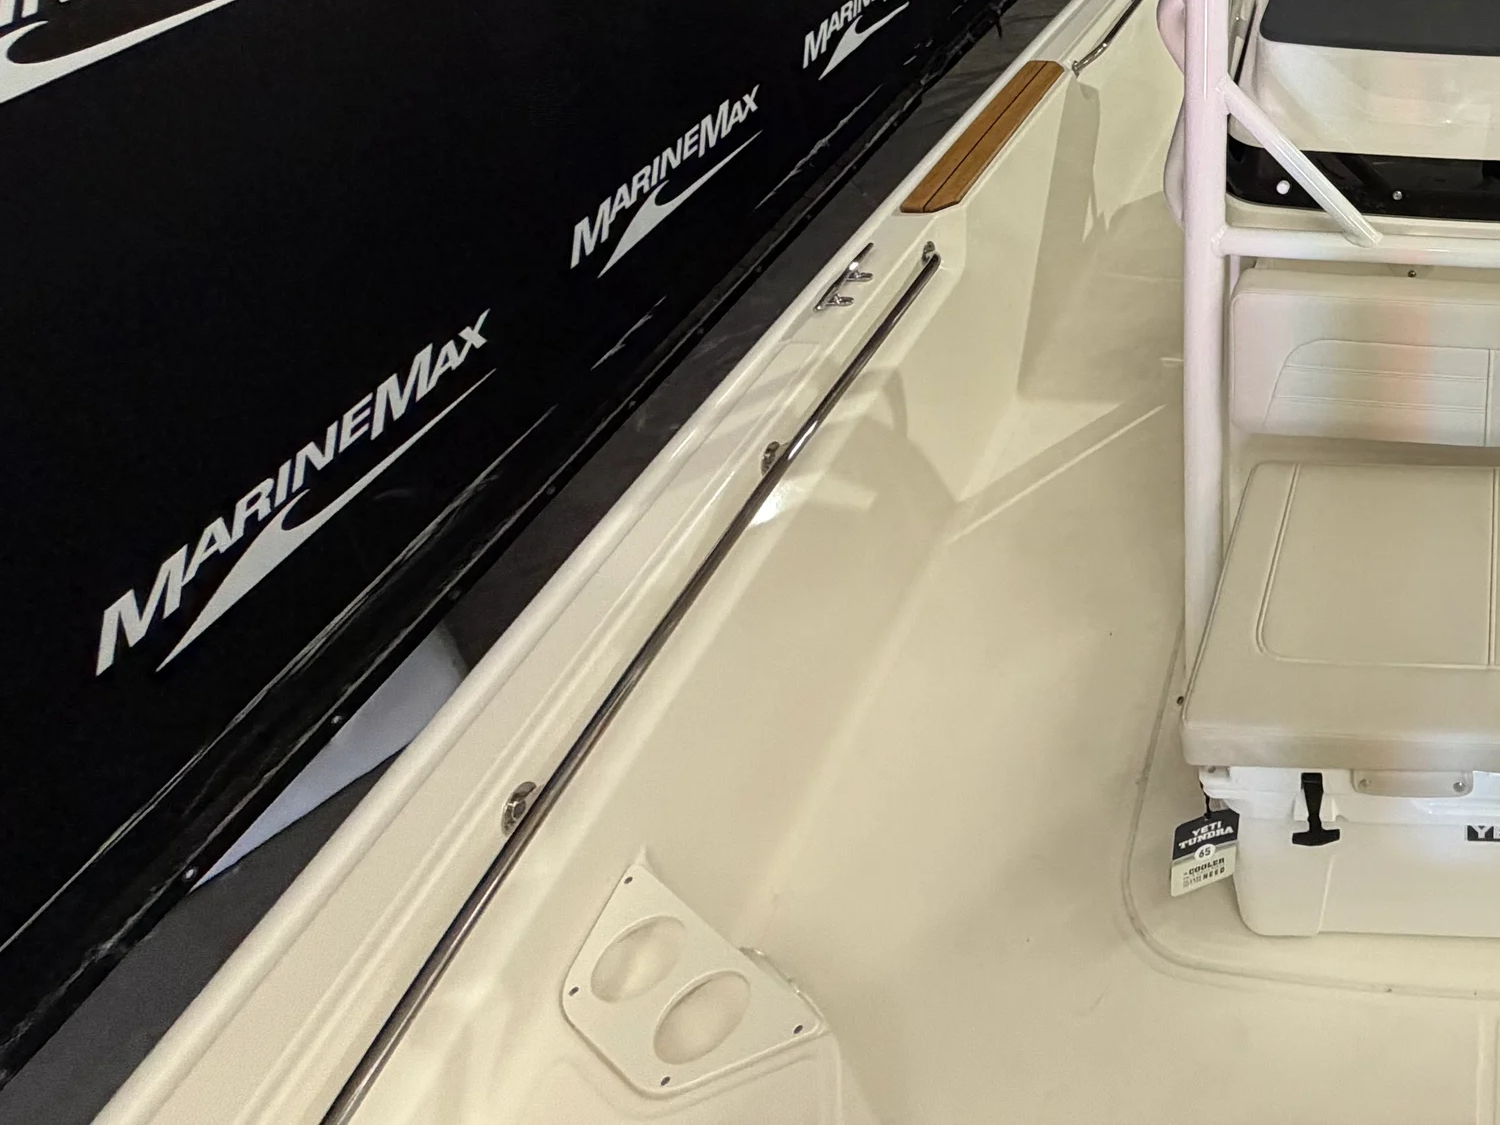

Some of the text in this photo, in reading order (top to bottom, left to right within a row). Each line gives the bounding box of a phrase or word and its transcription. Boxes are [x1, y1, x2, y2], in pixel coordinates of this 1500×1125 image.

[570, 84, 760, 269] MARINEMAX
[95, 308, 491, 676] MARINEMAX
[1178, 826, 1234, 849] TUNDRA
[1192, 821, 1222, 837] YETI
[1198, 847, 1211, 858] 65
[1188, 858, 1225, 875] COOLER
[1202, 866, 1225, 880] NEED
